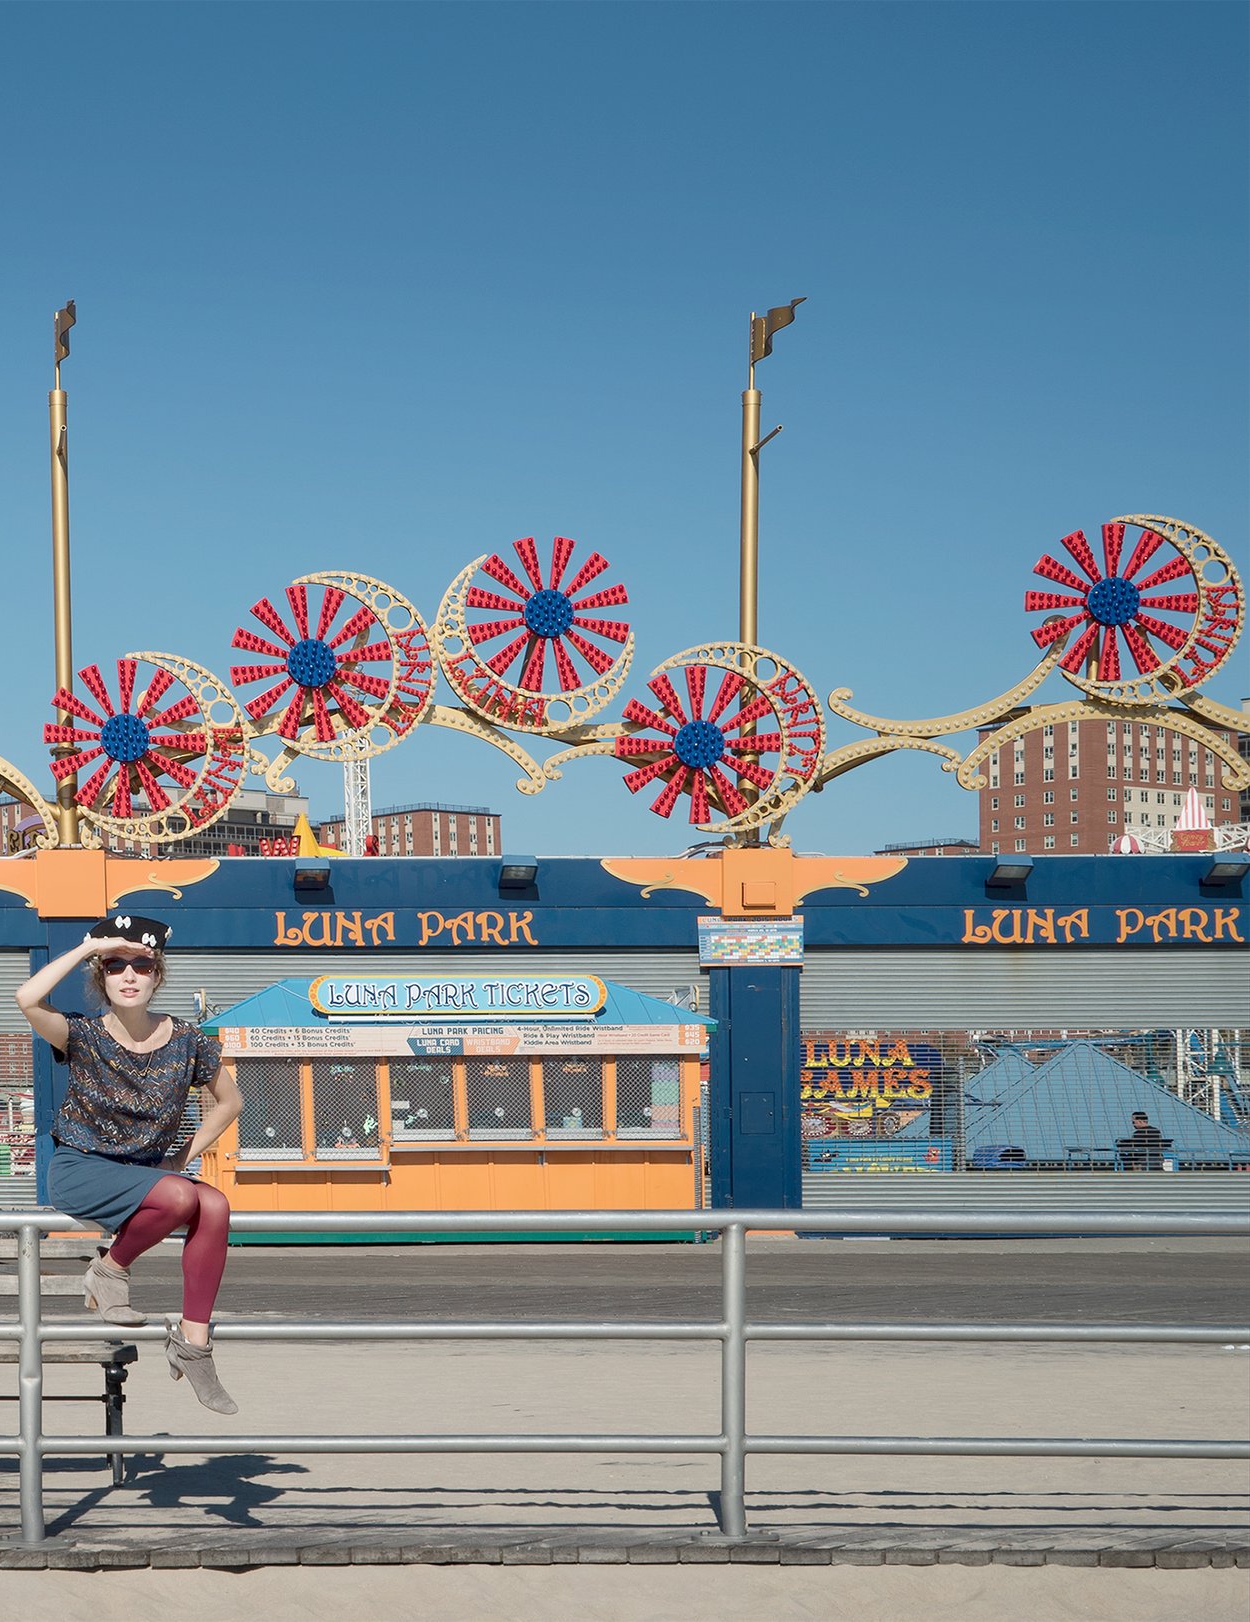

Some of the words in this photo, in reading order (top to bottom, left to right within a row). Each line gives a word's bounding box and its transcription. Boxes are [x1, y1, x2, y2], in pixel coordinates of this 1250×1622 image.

[1172, 586, 1240, 687] LUNA
[379, 627, 432, 736] LUNA
[446, 650, 546, 728] LUNA
[766, 669, 821, 779] LUNA
[182, 727, 244, 827] LUNA
[273, 911, 396, 946] LUNA
[417, 911, 538, 946] PARK
[962, 908, 1090, 944] LUNA
[1116, 907, 1245, 943] PARK
[328, 983, 398, 1009] LUNA
[405, 983, 478, 1010] PARK
[481, 983, 592, 1008] TICKETS
[422, 1027, 444, 1035] LUNA
[447, 1027, 469, 1035] PARK
[472, 1027, 504, 1035] PRICING
[426, 1046, 451, 1054] DEALS
[804, 1039, 915, 1067] LUNA
